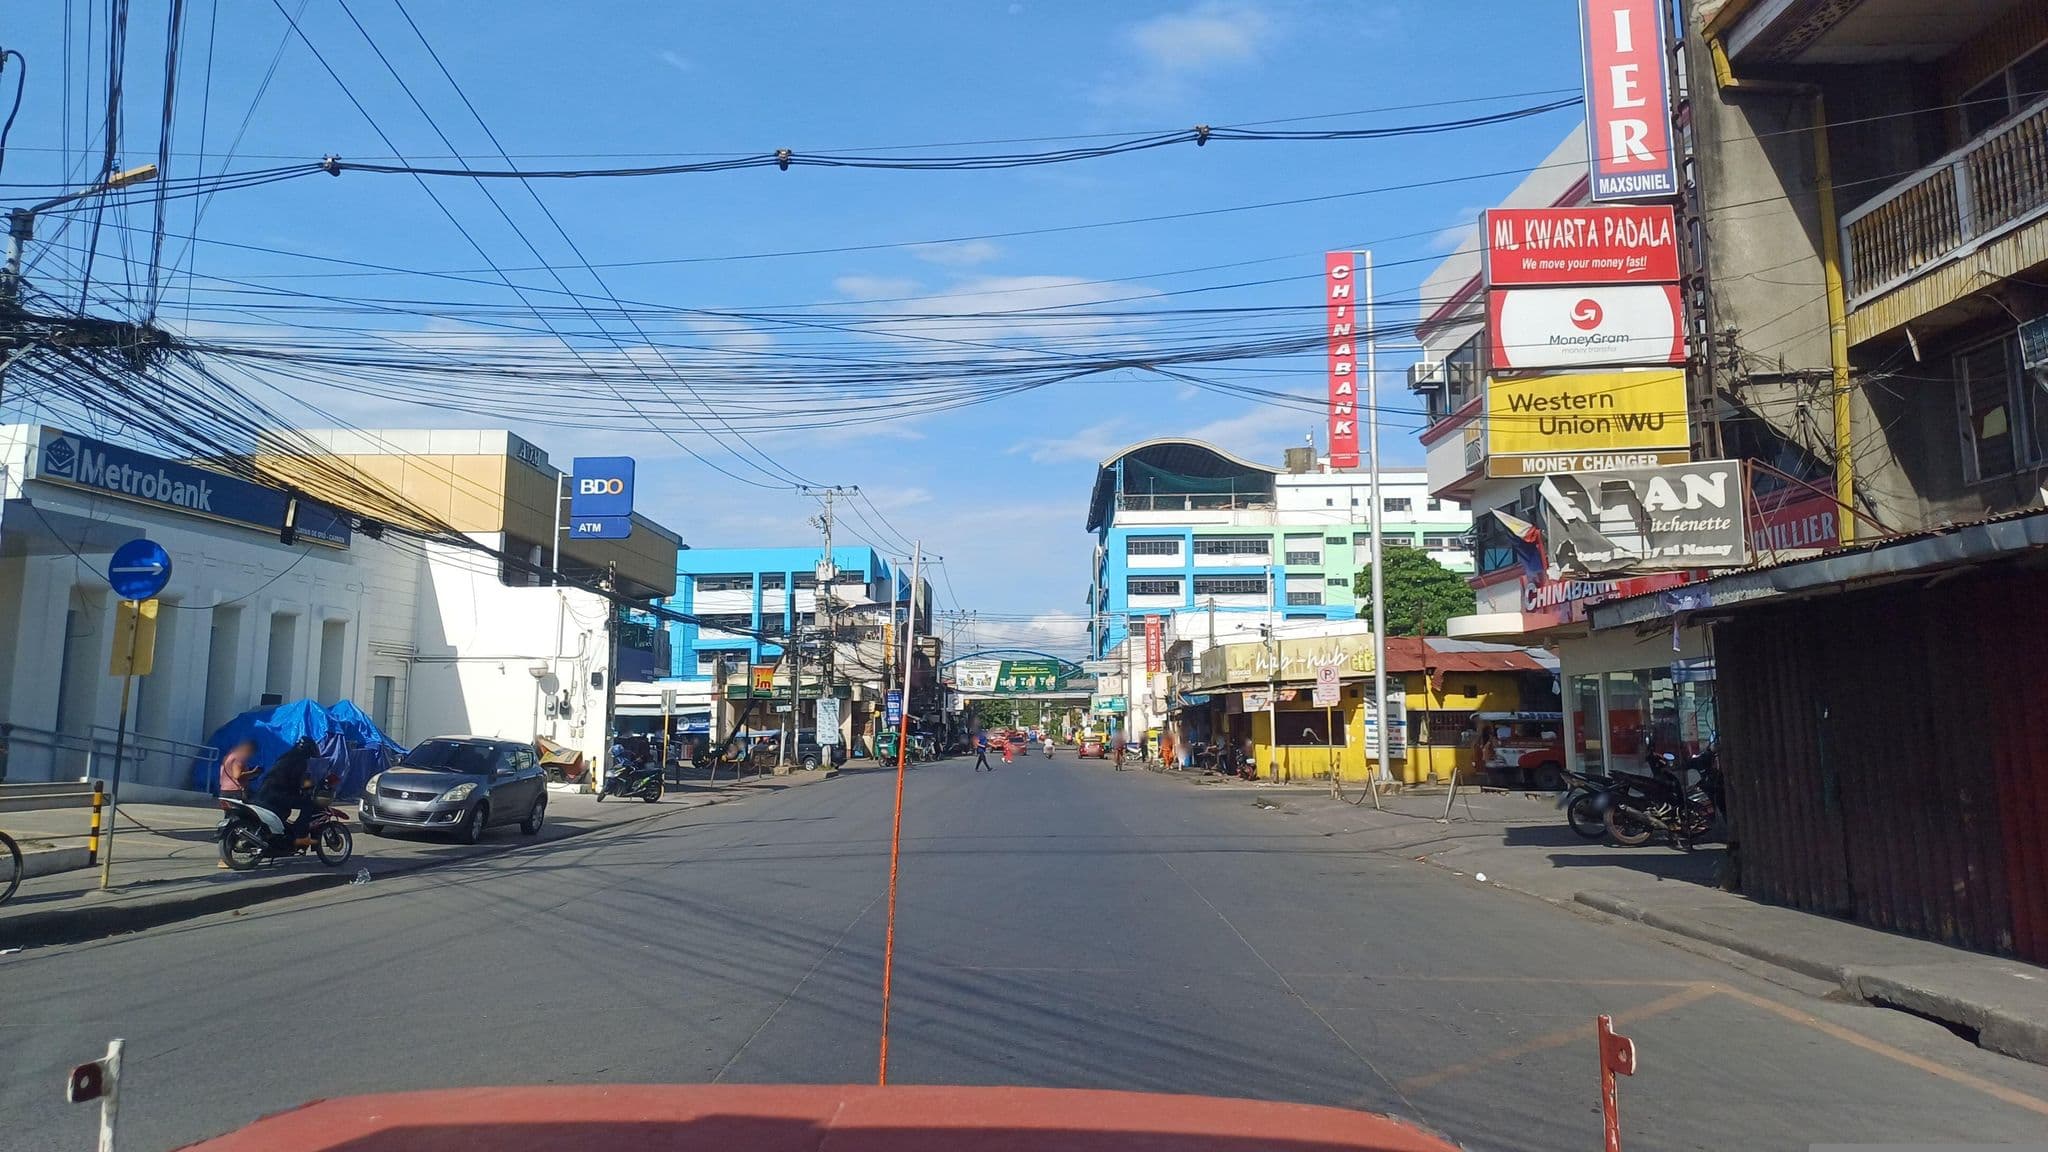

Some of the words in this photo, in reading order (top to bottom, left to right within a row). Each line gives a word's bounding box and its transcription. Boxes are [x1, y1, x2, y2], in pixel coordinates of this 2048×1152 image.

[1599, 173, 1670, 194] MAXSUNIEL
[1494, 219, 1520, 251] ML
[1525, 217, 1599, 250] KWARTA
[1604, 216, 1672, 248] PADALA
[1522, 258, 1537, 269] We
[1539, 259, 1565, 270] move
[1567, 259, 1590, 272] your
[1592, 258, 1624, 271] money
[1626, 256, 1648, 268] fast!
[1549, 332, 1629, 347] MoneyGram
[1331, 264, 1353, 435] CHINABANK
[1508, 391, 1614, 412] Western
[1538, 414, 1611, 435] Union
[1522, 457, 1578, 472] MONEY
[1582, 454, 1658, 470] CHANGER
[78, 449, 213, 512] Metrobank
[580, 478, 624, 495] BDO
[578, 522, 602, 533] ATM
[1651, 515, 1731, 532] itchenette
